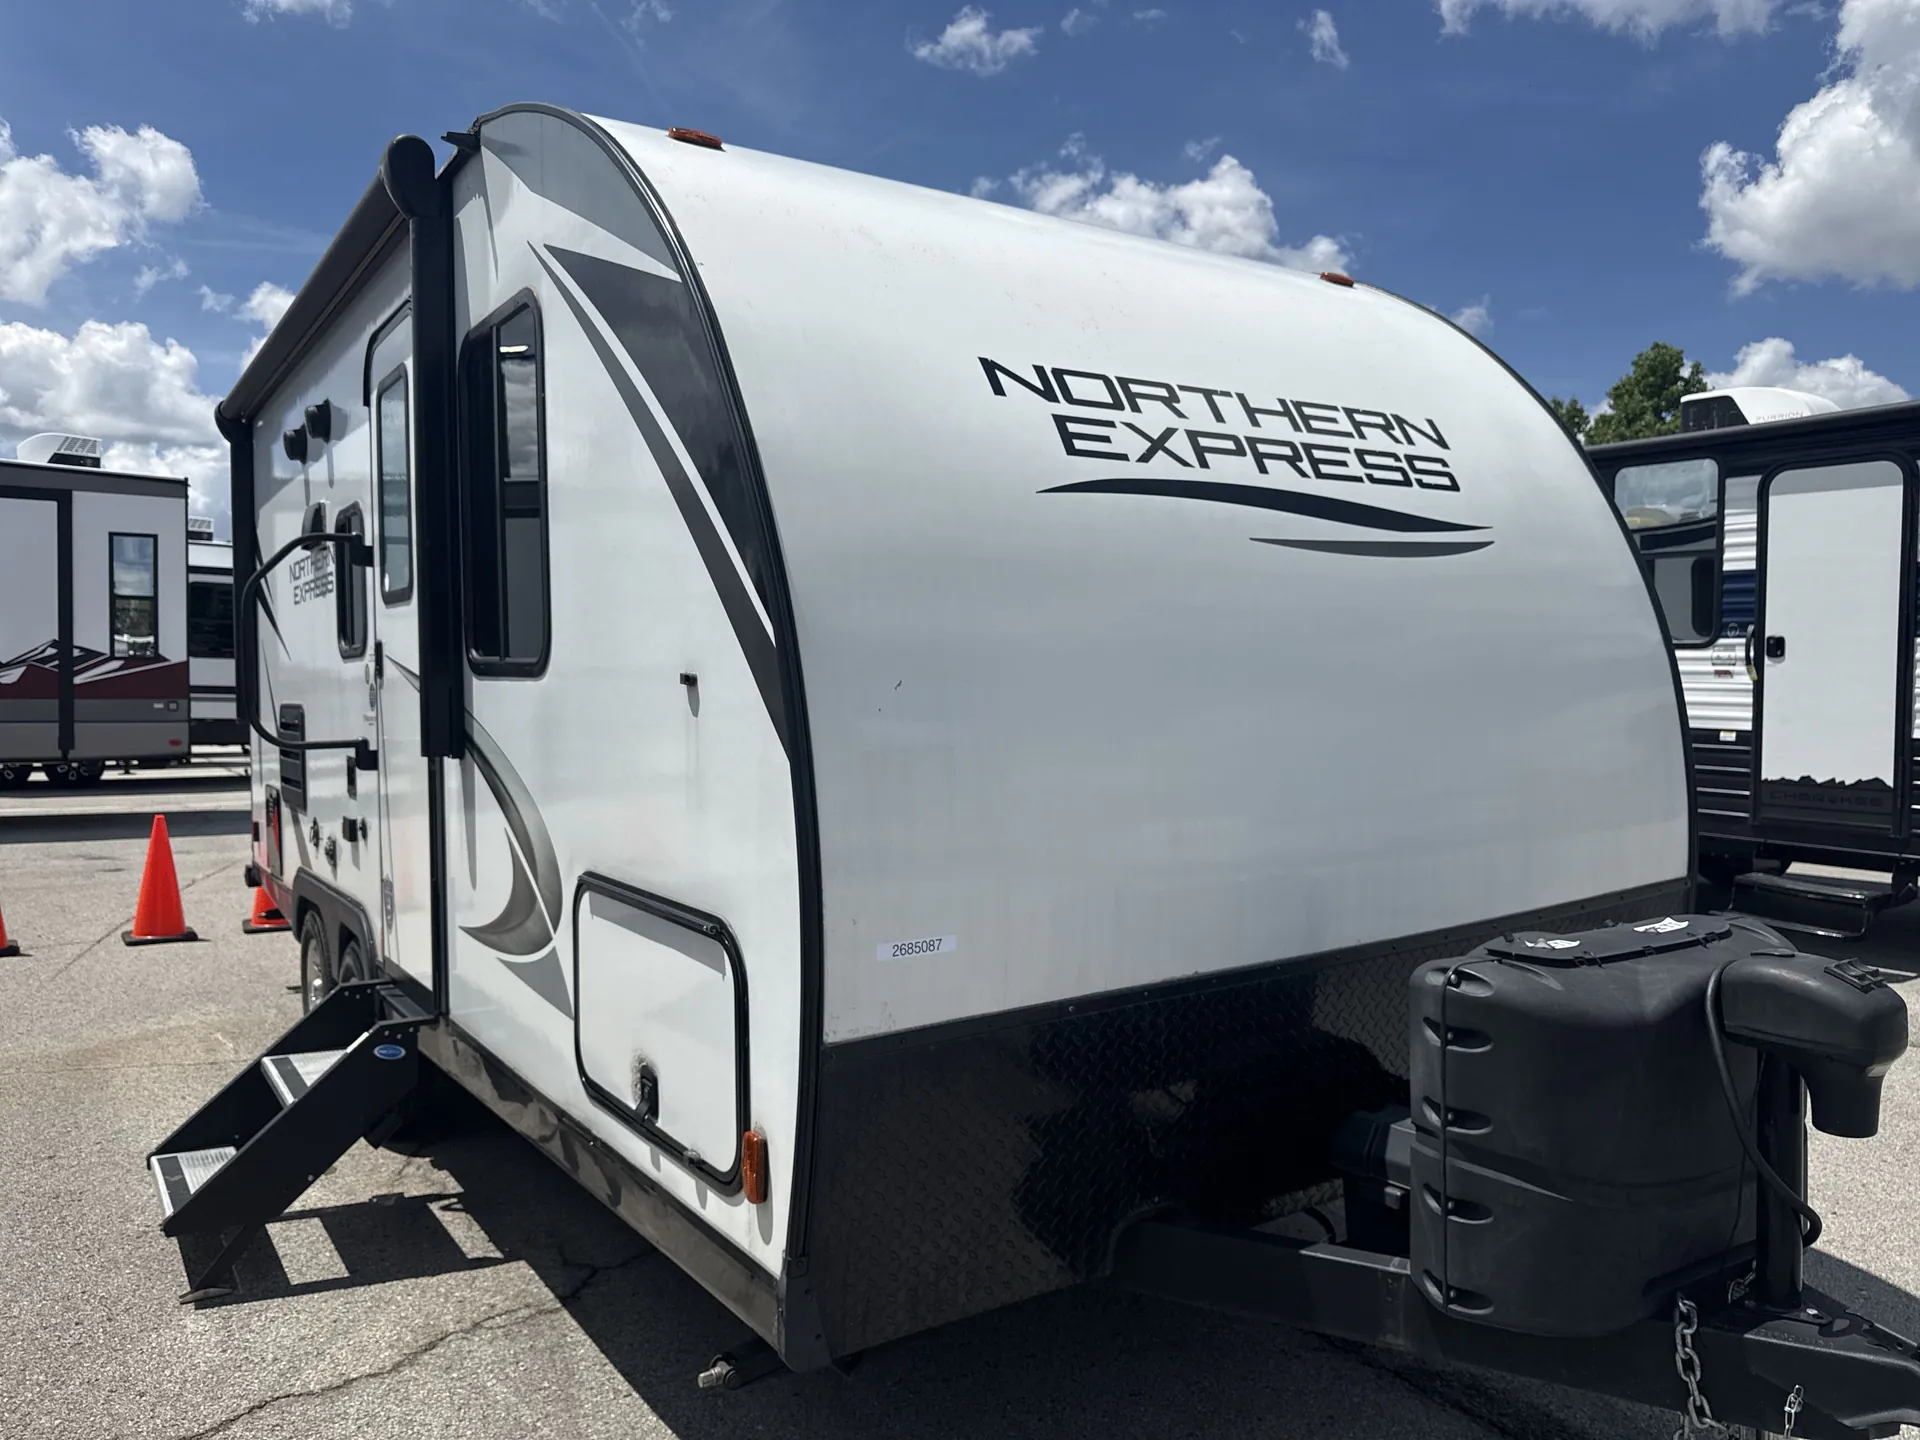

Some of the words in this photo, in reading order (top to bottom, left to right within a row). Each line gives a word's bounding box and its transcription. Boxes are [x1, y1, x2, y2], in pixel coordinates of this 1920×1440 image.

[977, 356, 1451, 450] NORTHERN
[1051, 413, 1461, 492] EXPRESS
[289, 543, 336, 584] NORTHERN
[293, 571, 334, 606] EXPRESS
[892, 938, 943, 957] 2685087
